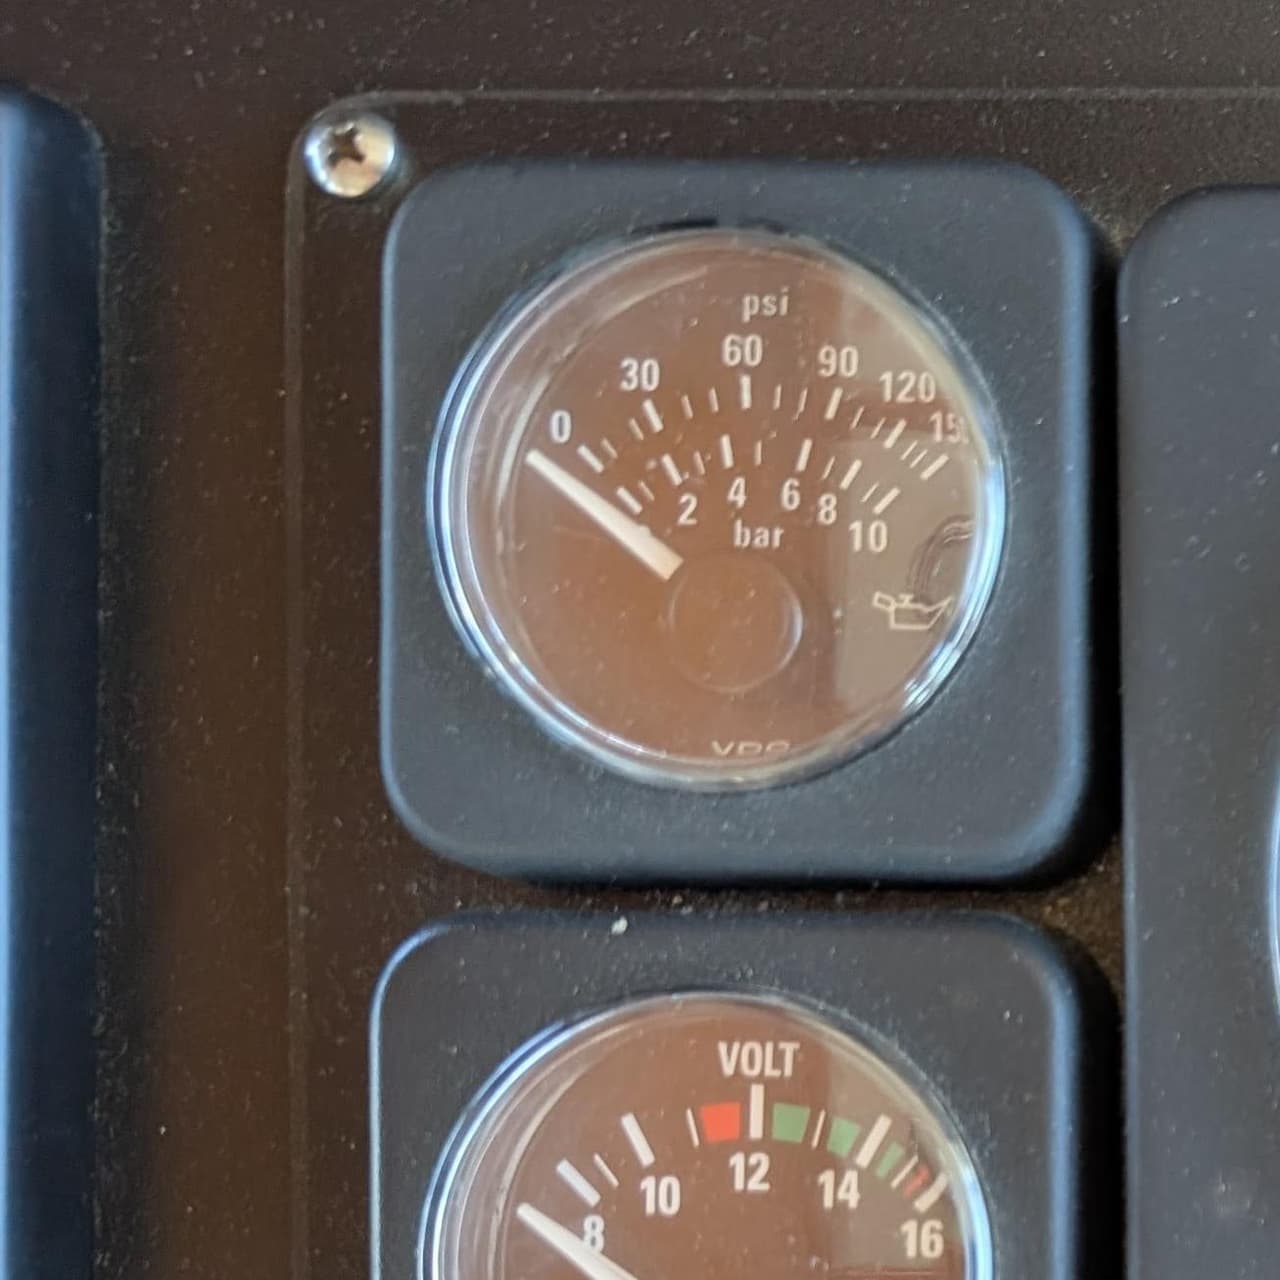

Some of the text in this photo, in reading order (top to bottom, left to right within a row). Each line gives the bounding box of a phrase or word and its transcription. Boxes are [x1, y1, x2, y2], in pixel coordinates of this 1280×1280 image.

[743, 287, 789, 322] psi
[723, 334, 763, 367] 60
[818, 345, 859, 377] 90
[620, 359, 660, 391] 30
[878, 371, 936, 403] 120
[550, 411, 571, 443] 0
[930, 410, 969, 444] 15
[728, 479, 746, 508] 4
[781, 480, 801, 511] 6
[816, 494, 837, 525] 8
[678, 496, 697, 525] 2
[733, 520, 783, 549] bar
[848, 522, 887, 553] 10
[718, 1041, 798, 1078] VOLT
[729, 1152, 770, 1191] 12
[640, 1176, 681, 1215] 10
[818, 1169, 861, 1209] 14
[582, 1214, 605, 1253] 8
[902, 1219, 943, 1258] 16
